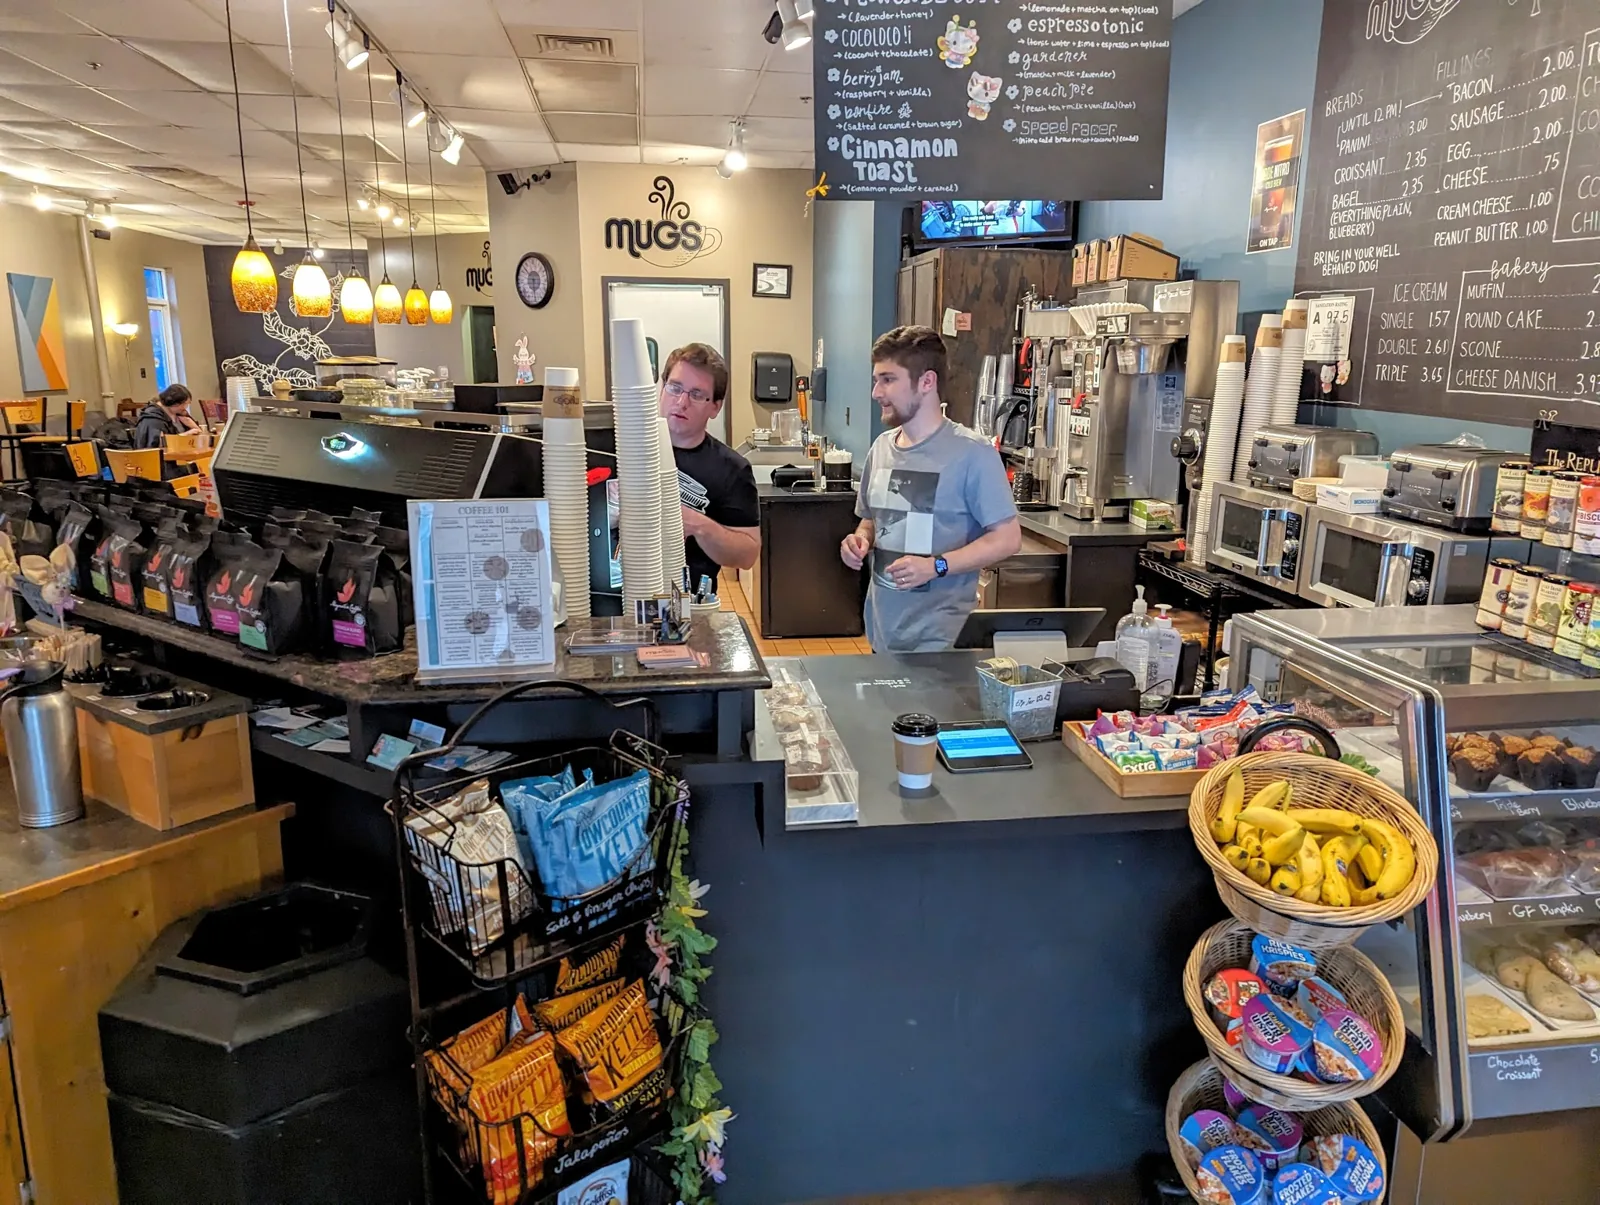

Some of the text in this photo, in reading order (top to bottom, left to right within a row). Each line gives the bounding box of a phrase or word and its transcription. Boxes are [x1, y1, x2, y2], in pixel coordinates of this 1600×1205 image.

[1022, 50, 1088, 70] gardener
[1453, 49, 1575, 104] BACON 2.00
[844, 103, 893, 120] bonfire
[1325, 89, 1364, 118] BREADS
[1449, 85, 1567, 131] SAUSAGE 2.00
[1341, 112, 1371, 134] UNTIL
[1374, 107, 1384, 122] 12
[841, 134, 958, 160] Cinnamon
[1339, 117, 1428, 157] PANINI 3.00
[1447, 120, 1562, 162] EGG 2.00
[1334, 148, 1428, 185] CROISSANT 2.35
[1443, 166, 1488, 190] CHEESE
[1332, 175, 1424, 210] BAGEL 2.35
[1437, 191, 1552, 220] CREAM CHEESE 1.00
[605, 217, 702, 259] MUGS
[1259, 237, 1279, 247] ON TAP
[1329, 221, 1375, 240] BLUEBERRY)
[1434, 228, 1471, 247] PEANUT
[1475, 221, 1519, 243] BUTTER
[1313, 243, 1401, 266] BRING IN YOUR WELL
[466, 267, 493, 292] MUG
[1322, 259, 1379, 277] BEHAVED DOG!
[1490, 256, 1548, 283] bakery
[1393, 281, 1448, 303] ICE CREAM
[1466, 282, 1505, 299] MUFFIN
[1313, 310, 1349, 324] A 97.5
[1380, 310, 1451, 330] SINGLE 1.57
[1464, 311, 1502, 329] POUND
[1506, 309, 1543, 329] CAKE
[1378, 338, 1418, 355] DOUBLE
[1460, 341, 1502, 358] SCONE
[1375, 364, 1443, 383] TRIPLE 3.65
[1455, 369, 1500, 388] CHEESE
[1503, 369, 1557, 392] DANISH
[1545, 448, 1566, 468] The
[458, 506, 509, 515] COFFEE 101
[1122, 760, 1156, 773] Extra
[1512, 904, 1535, 918] GF
[1539, 902, 1584, 917] Pumpkin
[546, 915, 571, 935] Salt
[1261, 945, 1306, 962] KRISPIES
[1268, 939, 1293, 951] RICE
[1250, 1012, 1281, 1046] Raisin
[1339, 1024, 1364, 1053] Bran
[1341, 1015, 1374, 1051] Raisin
[1488, 1053, 1540, 1069] Chocolate
[1497, 1066, 1543, 1080] Croissant
[1220, 1155, 1246, 1186] FLAKES
[1226, 1149, 1256, 1185] FROSTED
[1355, 1161, 1376, 1195] FROSTED
[1278, 1172, 1313, 1201] FROSTED
